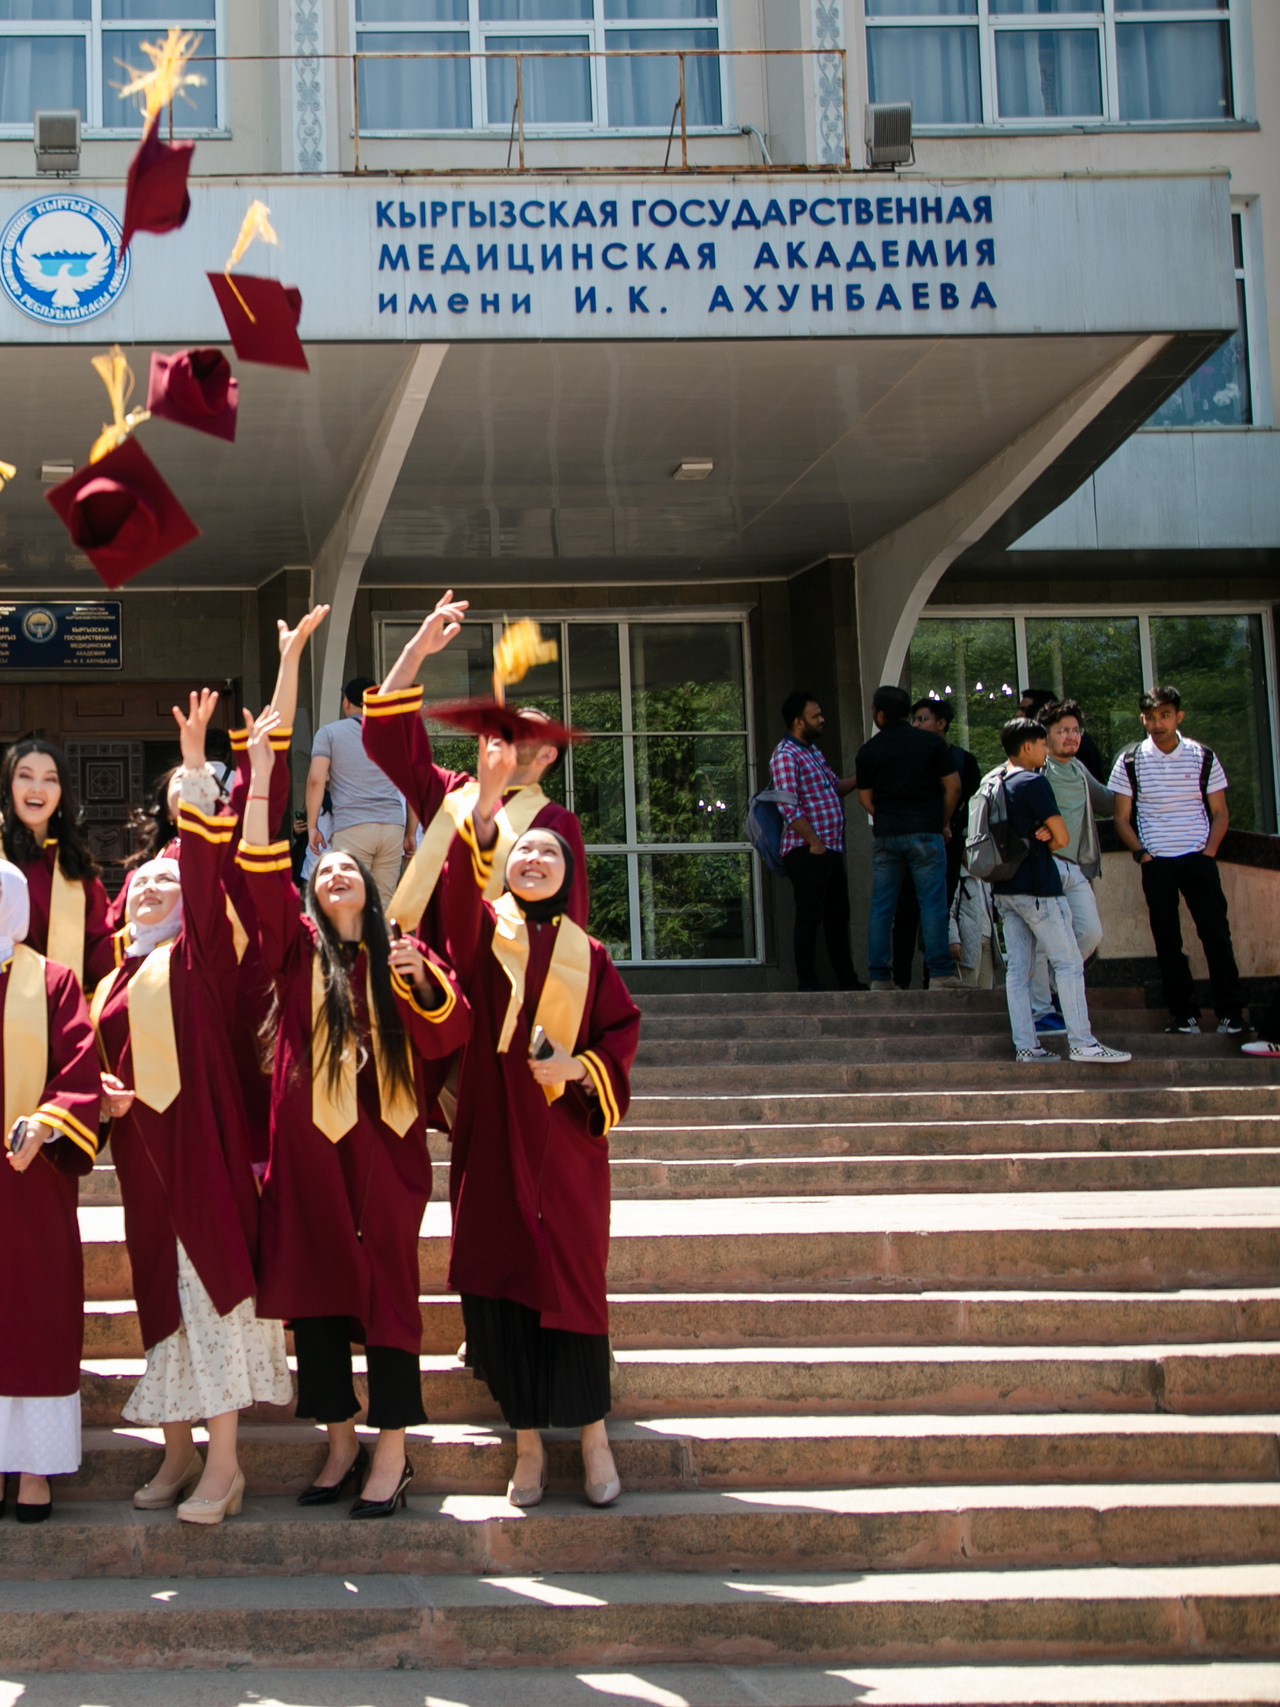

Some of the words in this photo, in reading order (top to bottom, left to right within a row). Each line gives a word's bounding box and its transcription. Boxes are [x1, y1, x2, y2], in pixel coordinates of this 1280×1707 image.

[35, 199, 90, 214] КЫРГЫЗ
[376, 199, 618, 228] КЫРГЫЗСКАЯ
[632, 195, 993, 229] ГОСУДАРСТВЕННАЯ
[378, 242, 718, 274] МЕДИЦИНСКАЯ
[753, 238, 996, 271] АКАДЕМИЯ
[379, 292, 531, 313] имени
[575, 285, 668, 313] И.К.
[708, 281, 998, 312] АХУНБАЕВА
